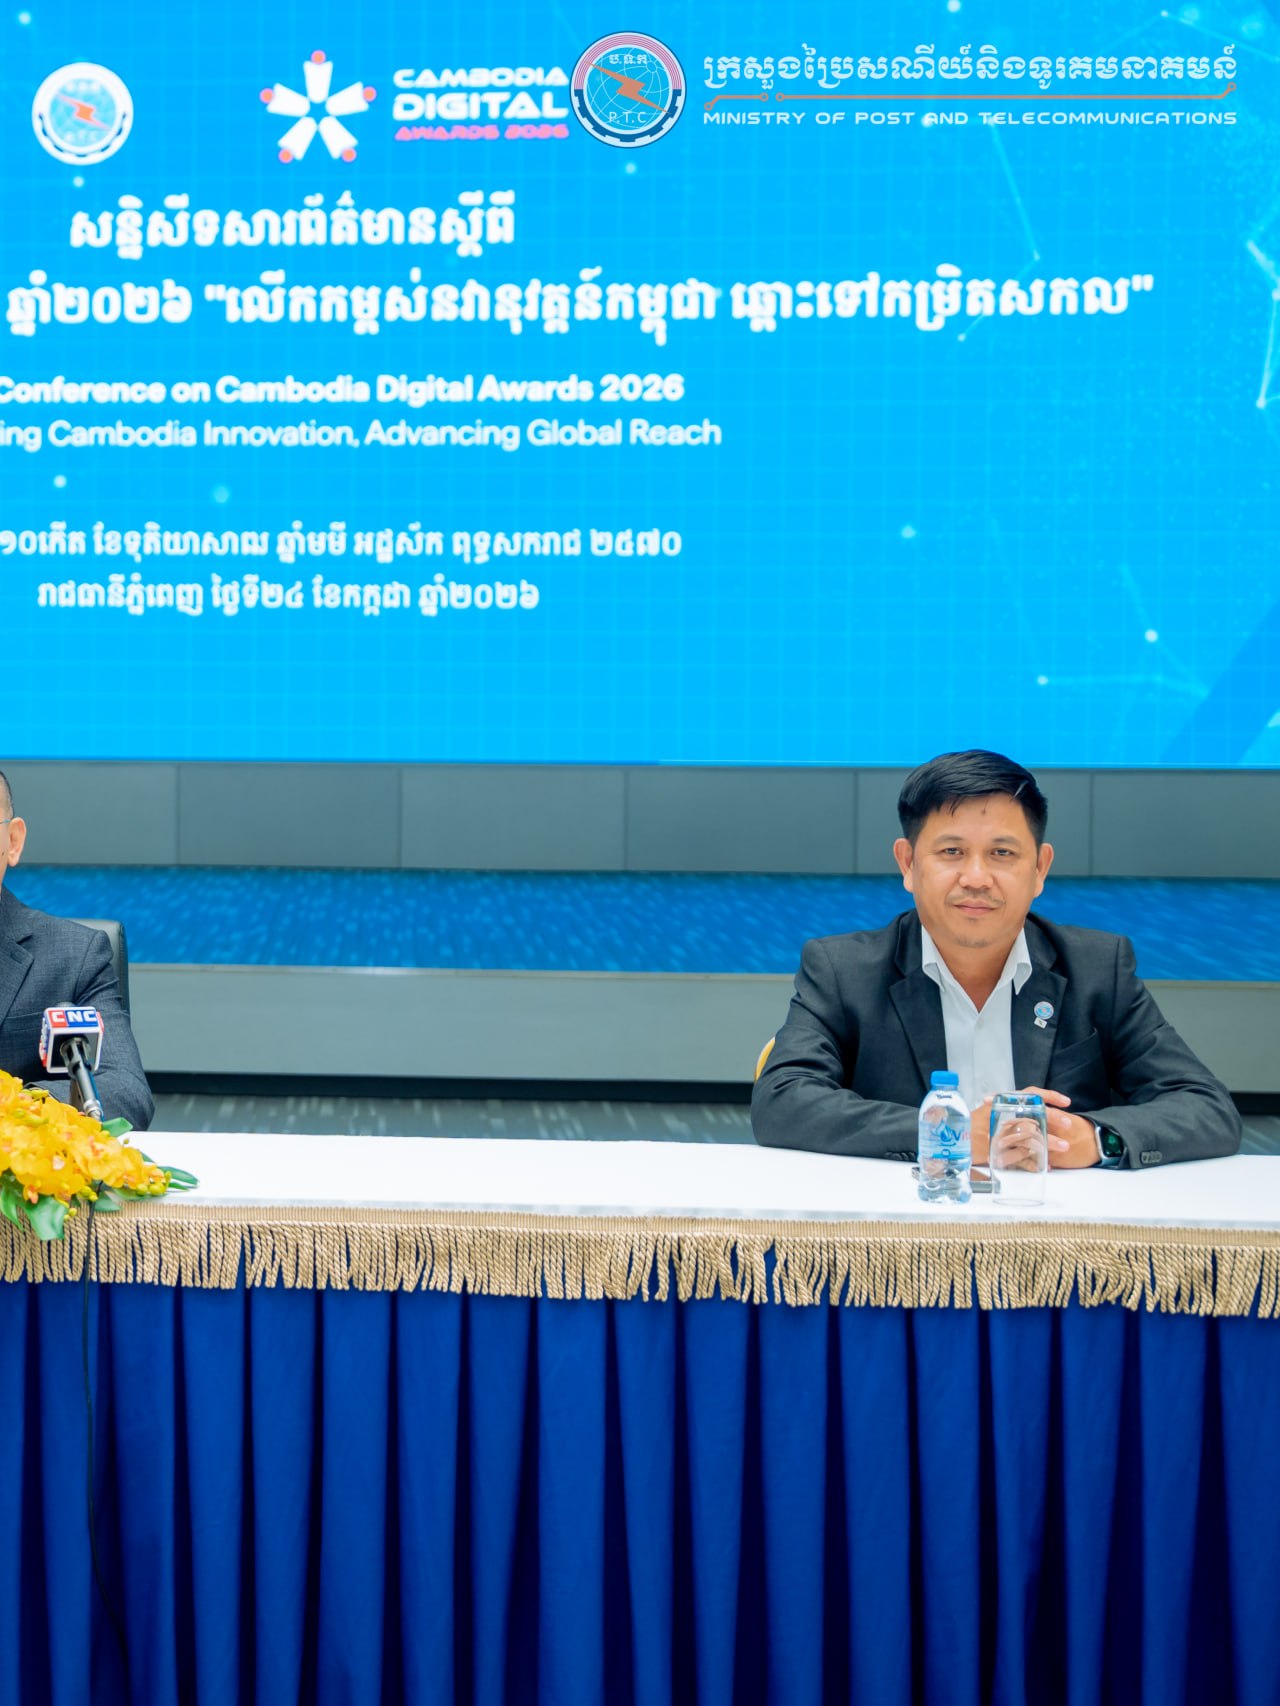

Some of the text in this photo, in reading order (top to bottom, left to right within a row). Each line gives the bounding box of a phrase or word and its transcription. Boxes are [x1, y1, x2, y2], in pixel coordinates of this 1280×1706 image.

[394, 67, 569, 88] CAMBODIA
[393, 92, 569, 120] DIGITAL
[394, 124, 570, 141] AWARDS 2026
[6, 269, 193, 337] ឆ្នាំ២០២៦
[171, 382, 211, 403] on
[215, 374, 371, 403] Cambodia
[376, 374, 474, 408] Digital
[477, 374, 595, 403] Awards
[599, 373, 685, 402] 2026
[47, 419, 197, 447] Cambodia
[203, 419, 360, 449] Innovation,
[364, 419, 521, 452] Advancing
[526, 418, 623, 446] Global
[629, 418, 722, 446] Reach
[590, 528, 682, 557] ២៥៧០
[37, 572, 204, 616] រាជធានីភ្នំពេញ
[211, 573, 304, 616] ថ្ងៃទី២៤
[418, 573, 540, 617] ឆ្នាំ២០២៦
[51, 1010, 97, 1023] CNC
